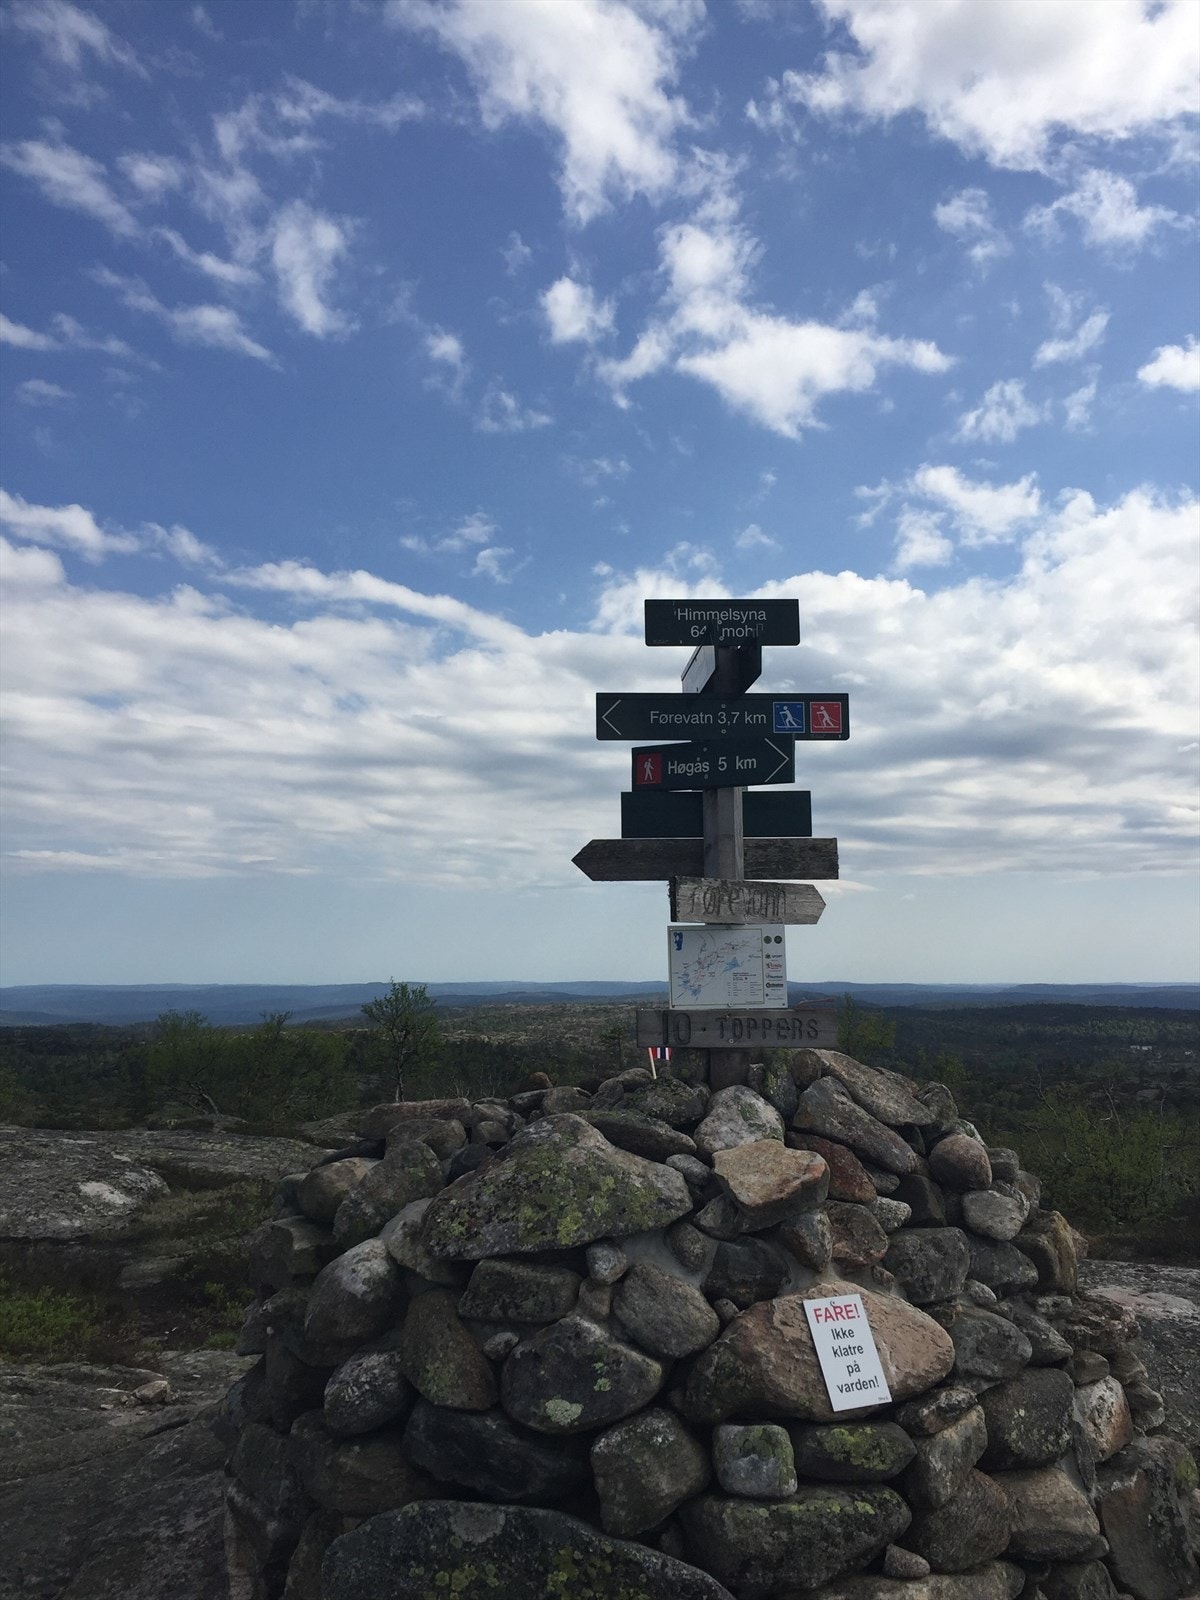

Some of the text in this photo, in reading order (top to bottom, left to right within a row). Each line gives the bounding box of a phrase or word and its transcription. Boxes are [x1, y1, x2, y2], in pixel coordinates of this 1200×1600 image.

[677, 607, 767, 624] Himmelsyna
[650, 710, 767, 726] Førevatn 3,7 km
[667, 755, 757, 775] Høgås 5 km
[813, 1303, 861, 1324] FARE!
[831, 1327, 855, 1341] Ikke
[832, 1344, 864, 1358] klatre
[846, 1360, 861, 1377] på
[836, 1375, 880, 1394] varden!
